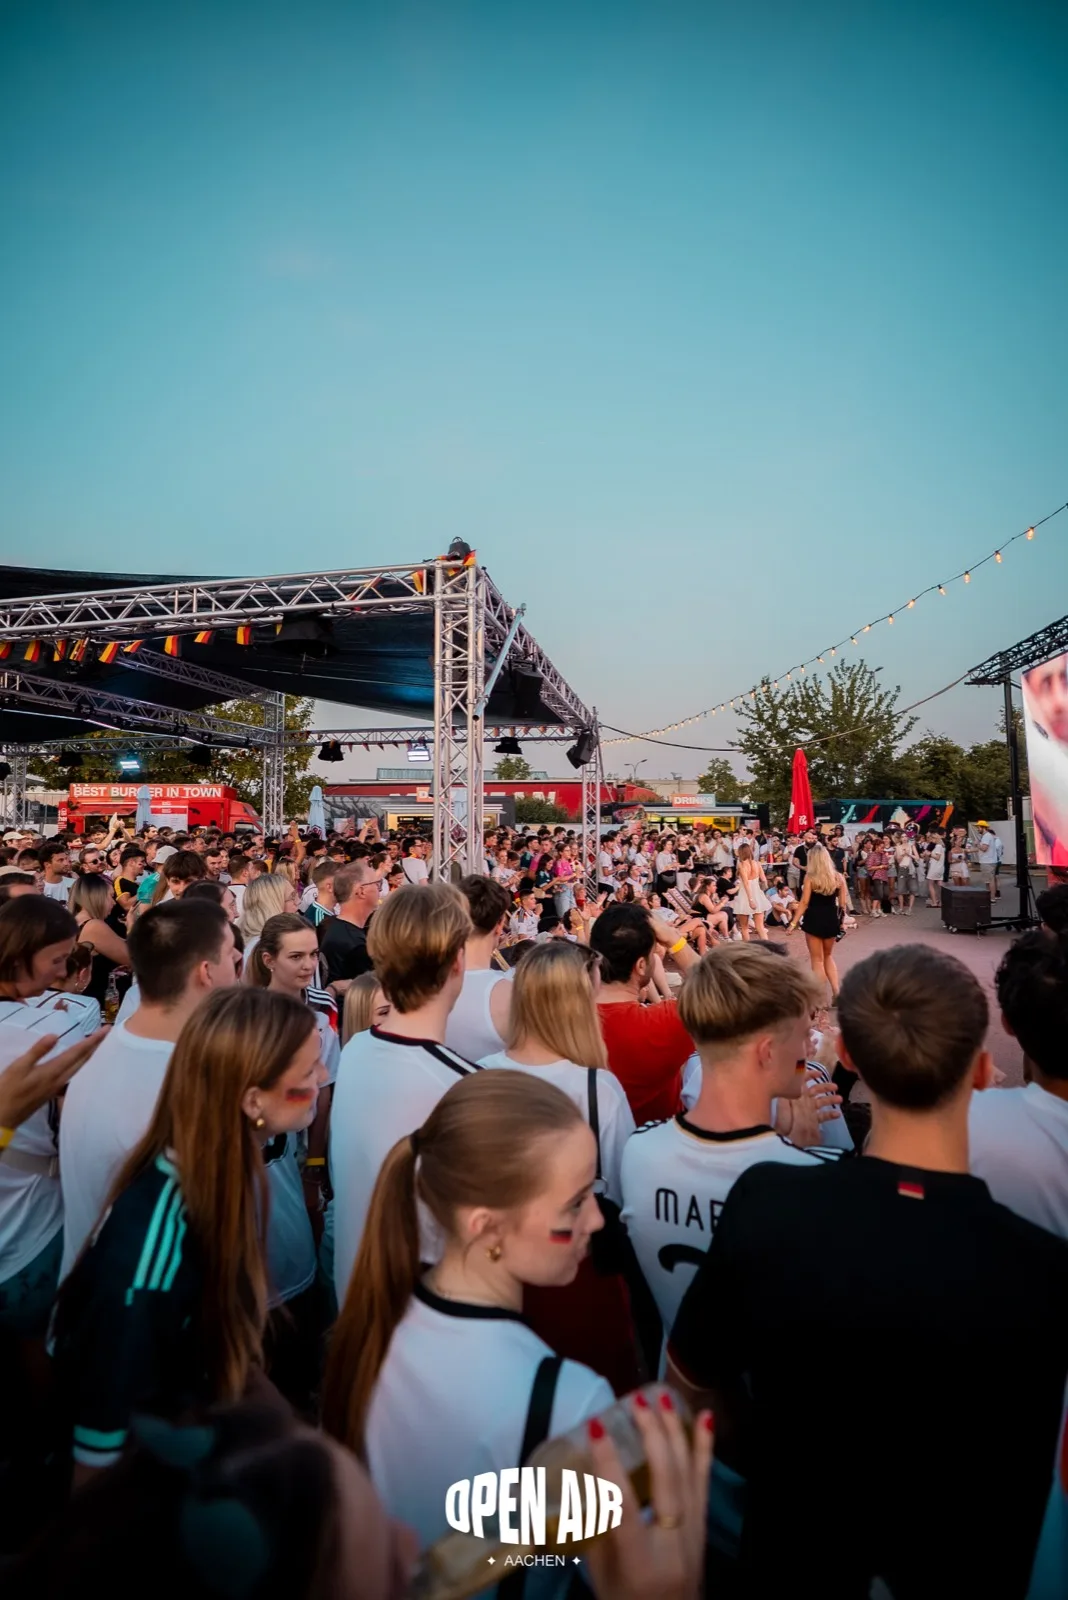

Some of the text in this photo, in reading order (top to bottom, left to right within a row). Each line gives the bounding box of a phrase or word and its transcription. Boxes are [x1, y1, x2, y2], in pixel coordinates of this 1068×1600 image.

[73, 786, 222, 798] BEST BURER IN TOWN
[673, 796, 713, 805] DRINKS
